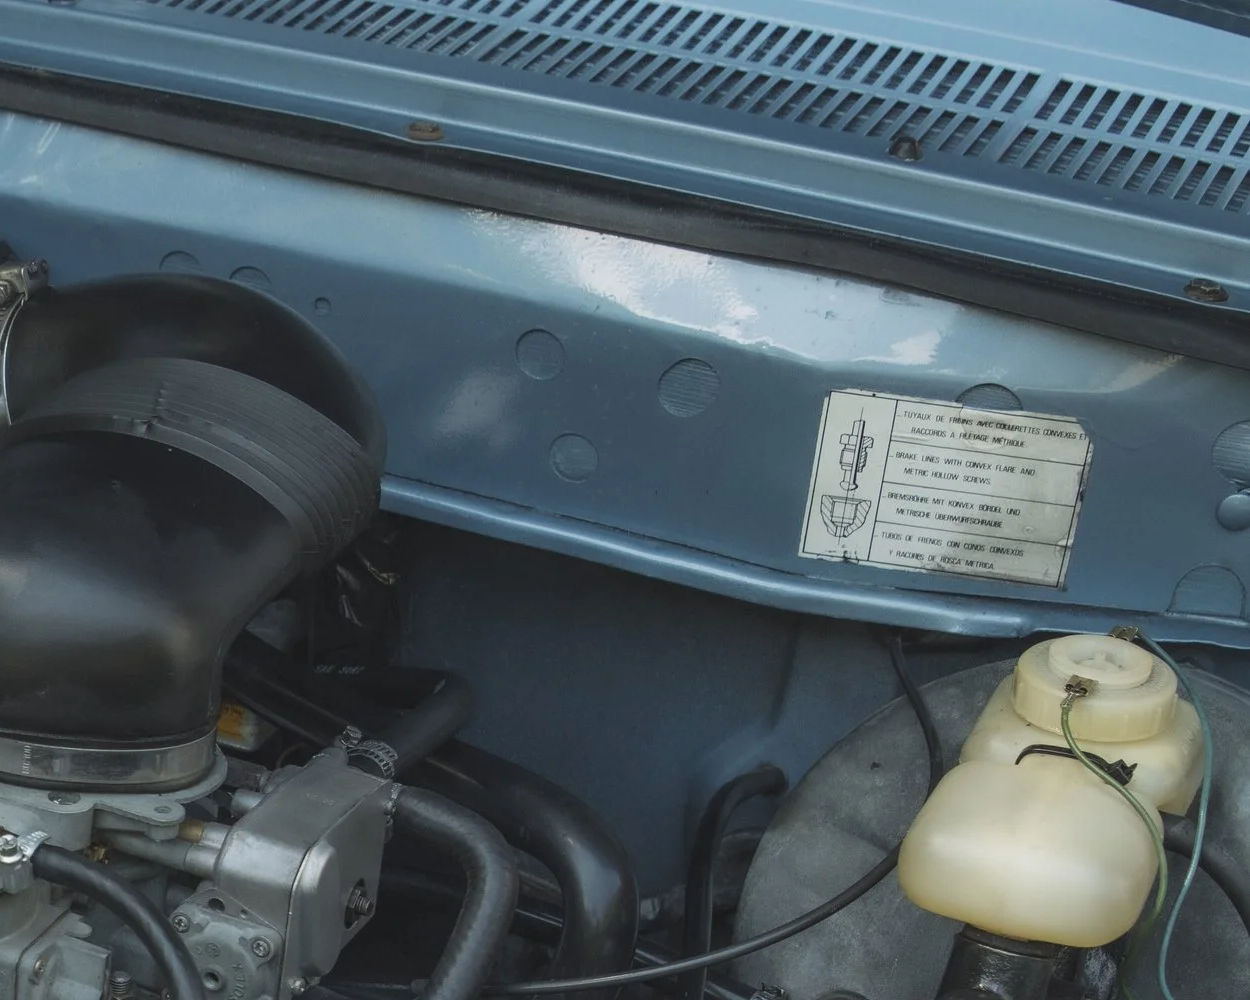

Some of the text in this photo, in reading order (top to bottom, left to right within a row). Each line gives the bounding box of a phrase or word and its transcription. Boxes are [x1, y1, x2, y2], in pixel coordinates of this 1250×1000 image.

[903, 410, 931, 421] TUYAUX
[935, 415, 944, 423] DE
[976, 420, 994, 429] AVEC
[995, 421, 1040, 435] COLLERETTES
[1042, 428, 1077, 440] CONVEXES
[911, 427, 947, 438] RACCORDS
[959, 432, 989, 443] FILETAGE
[895, 451, 1036, 476] BRAKE LINES WITH CONVEX FLARE AND
[904, 467, 991, 485] METRIC HOLLOW SCREWS
[896, 507, 931, 519] METRISCHE
[932, 497, 945, 506] MIT
[948, 499, 975, 510] KONVEX
[1006, 507, 1021, 516] UND
[881, 531, 1024, 557] TUBOS DE FRENOS CON CONOS CONVEXOS
[896, 551, 925, 561] RACORES
[927, 554, 937, 563] DE
[940, 556, 962, 566] ROSCA
